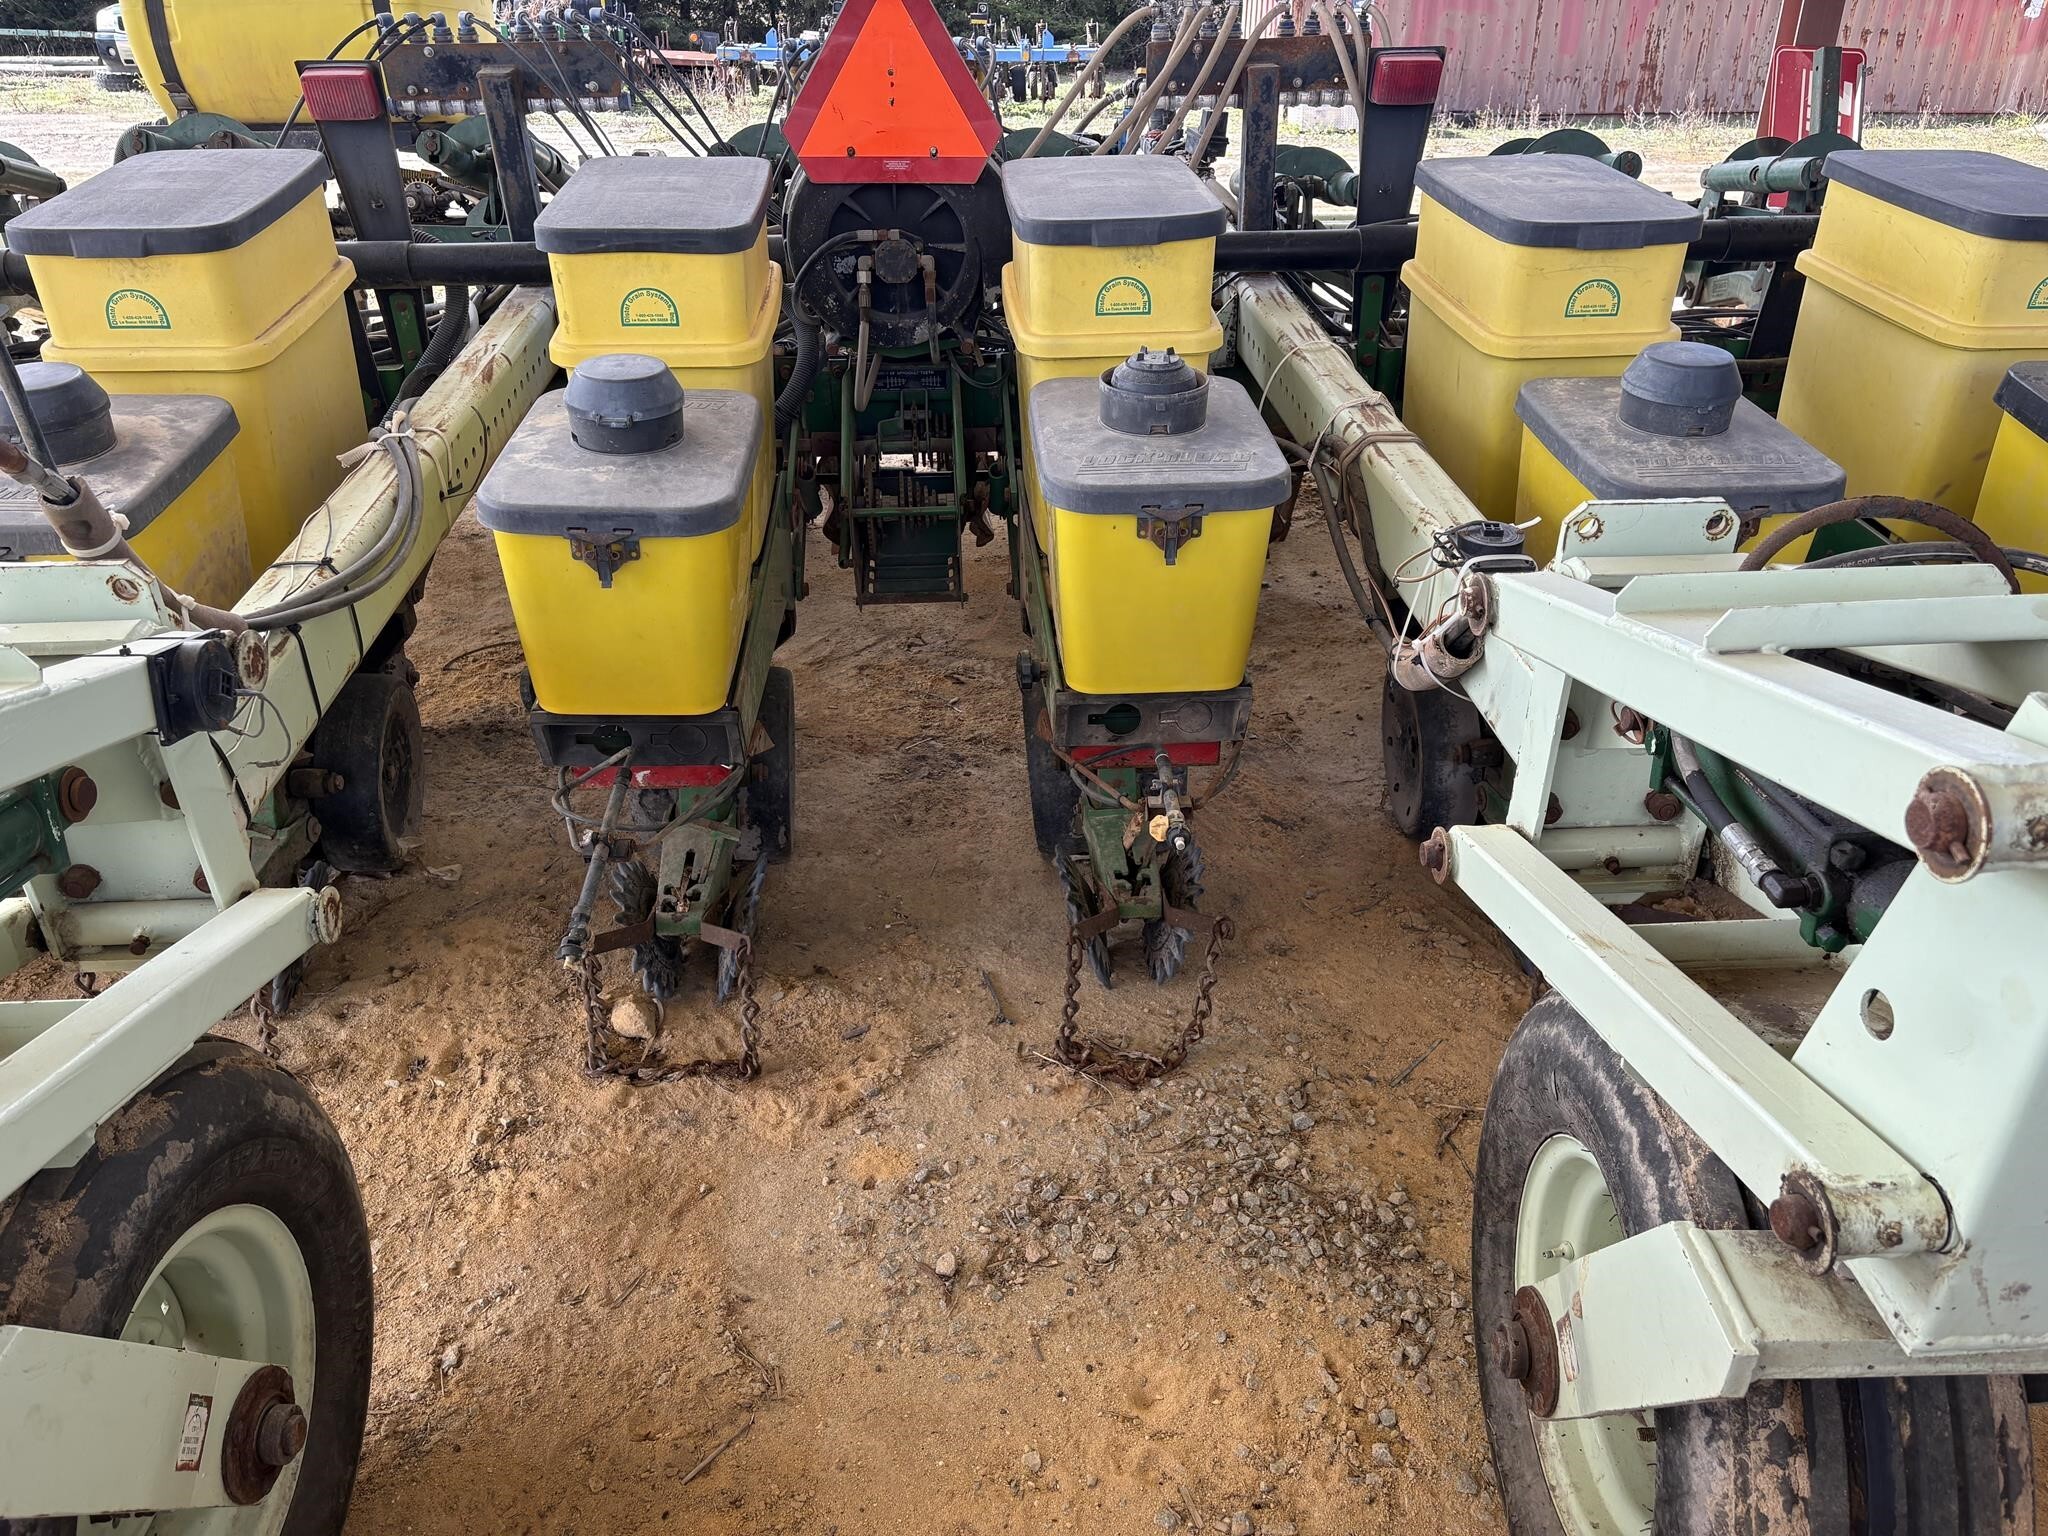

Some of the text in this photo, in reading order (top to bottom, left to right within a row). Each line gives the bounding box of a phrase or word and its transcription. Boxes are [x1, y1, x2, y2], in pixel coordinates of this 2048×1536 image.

[111, 292, 129, 306] Grain
[628, 291, 645, 304] Grain
[1099, 293, 1107, 313] Distel
[1104, 280, 1122, 293] Grain
[1568, 295, 1578, 315] Distel
[1577, 283, 1595, 295] Grain
[109, 305, 118, 326] Distel
